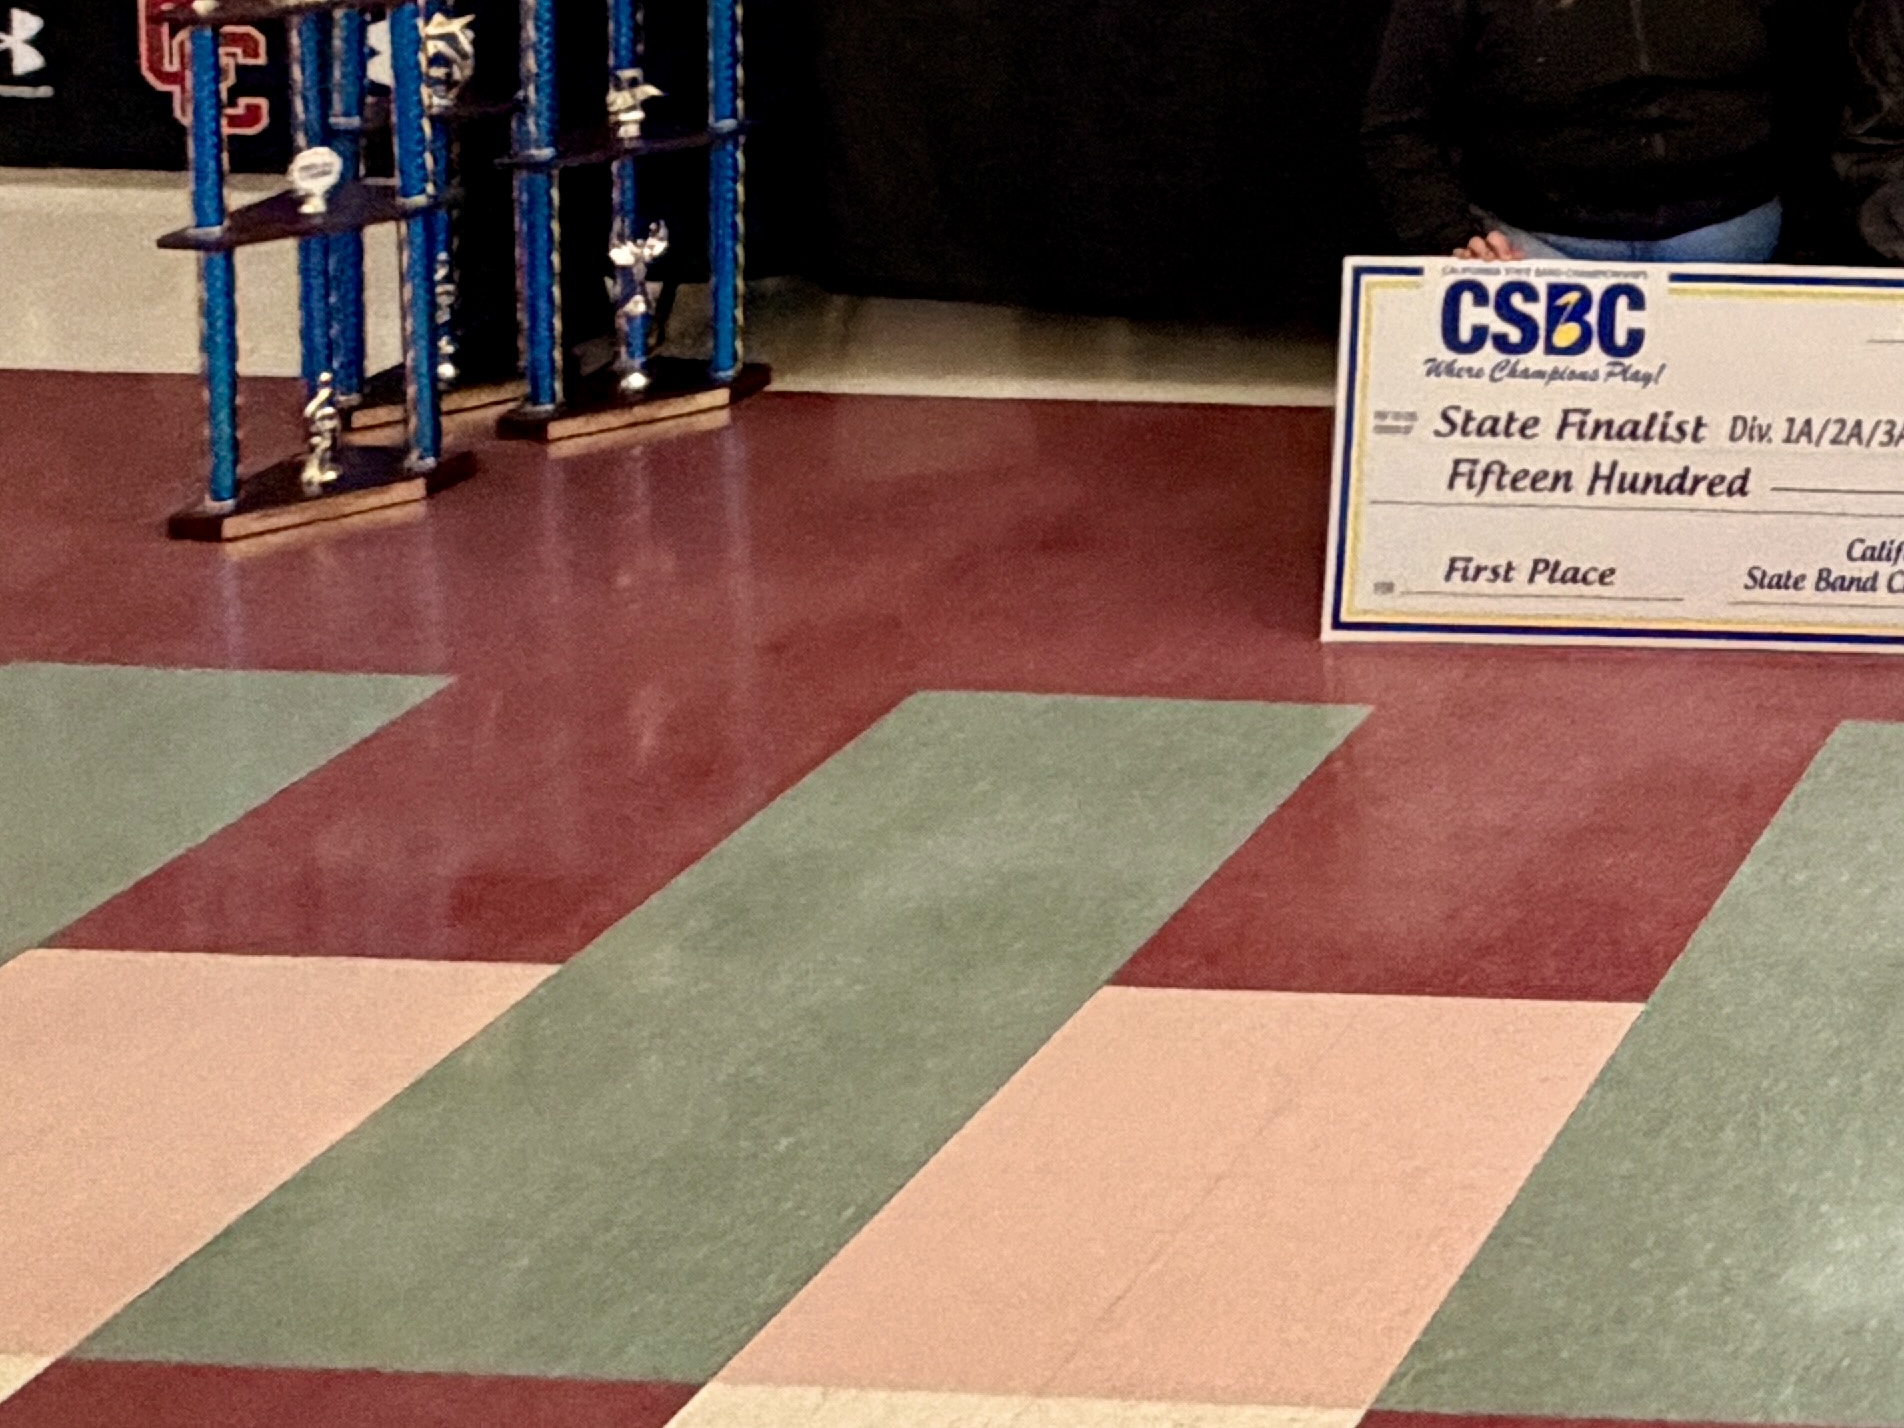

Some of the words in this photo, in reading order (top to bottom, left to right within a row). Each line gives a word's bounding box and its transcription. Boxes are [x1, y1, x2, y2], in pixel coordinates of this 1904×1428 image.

[1441, 280, 1647, 357] CSBC
[1423, 358, 1485, 381] Where
[1489, 359, 1599, 386] Champions
[1603, 363, 1666, 388] Play!
[1433, 406, 1541, 438] State
[1556, 408, 1707, 444] Finalist
[1728, 415, 1773, 442] Div.
[1447, 458, 1574, 497] Fifteen
[1587, 461, 1752, 497] Hundred
[1443, 556, 1517, 586] First
[1529, 558, 1617, 588] Place
[1743, 565, 1808, 592] State
[1814, 567, 1879, 595] Band
